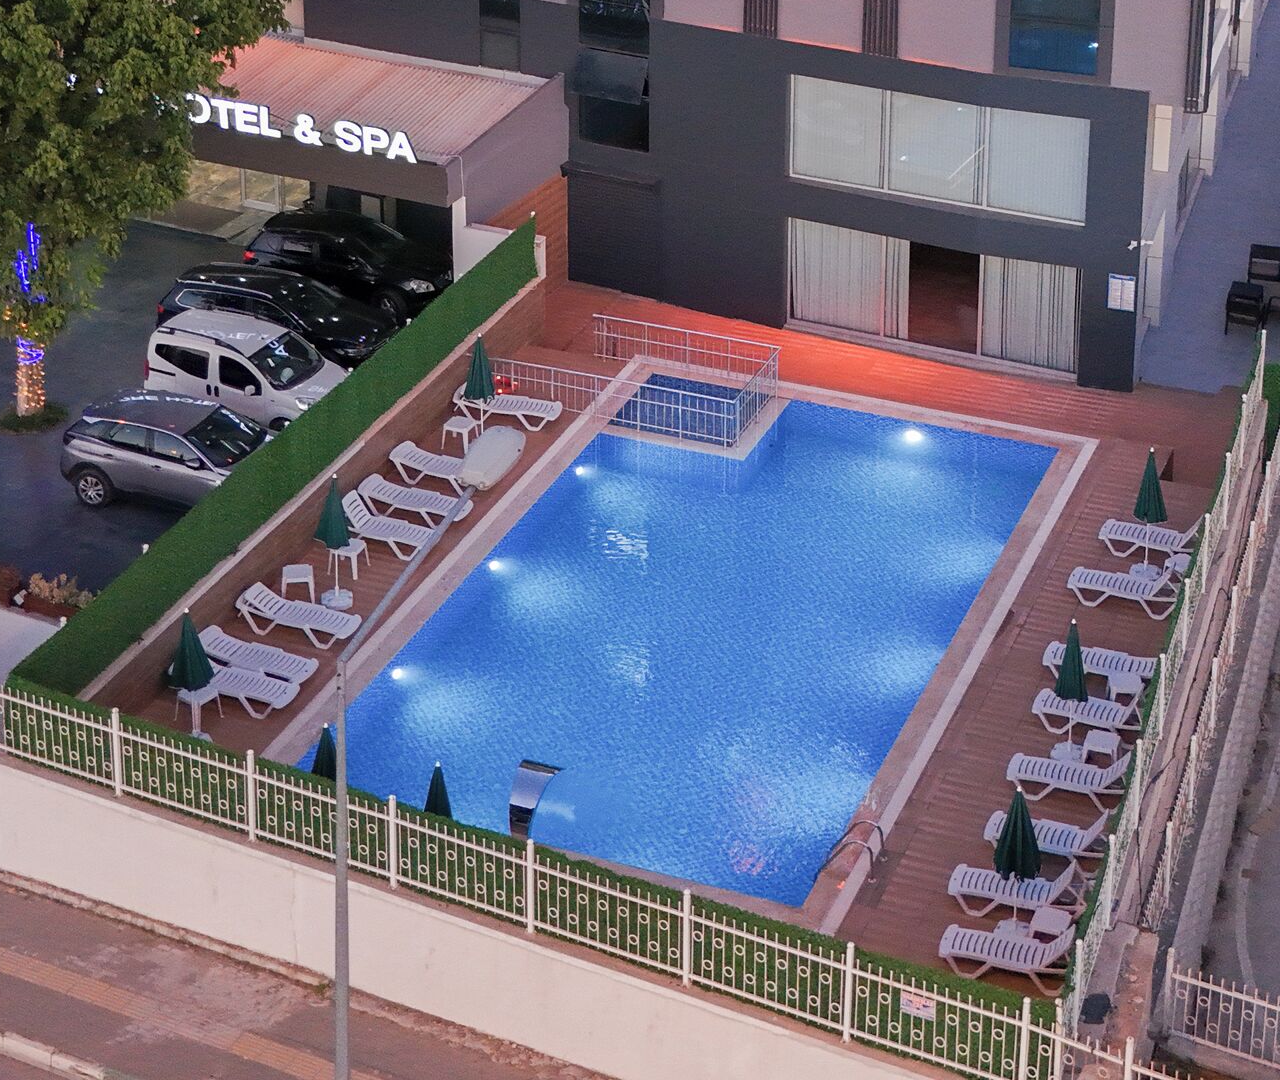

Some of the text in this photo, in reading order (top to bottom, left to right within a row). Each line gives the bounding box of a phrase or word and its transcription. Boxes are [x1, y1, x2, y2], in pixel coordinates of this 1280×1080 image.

[187, 92, 418, 164] OTEL & SPA
